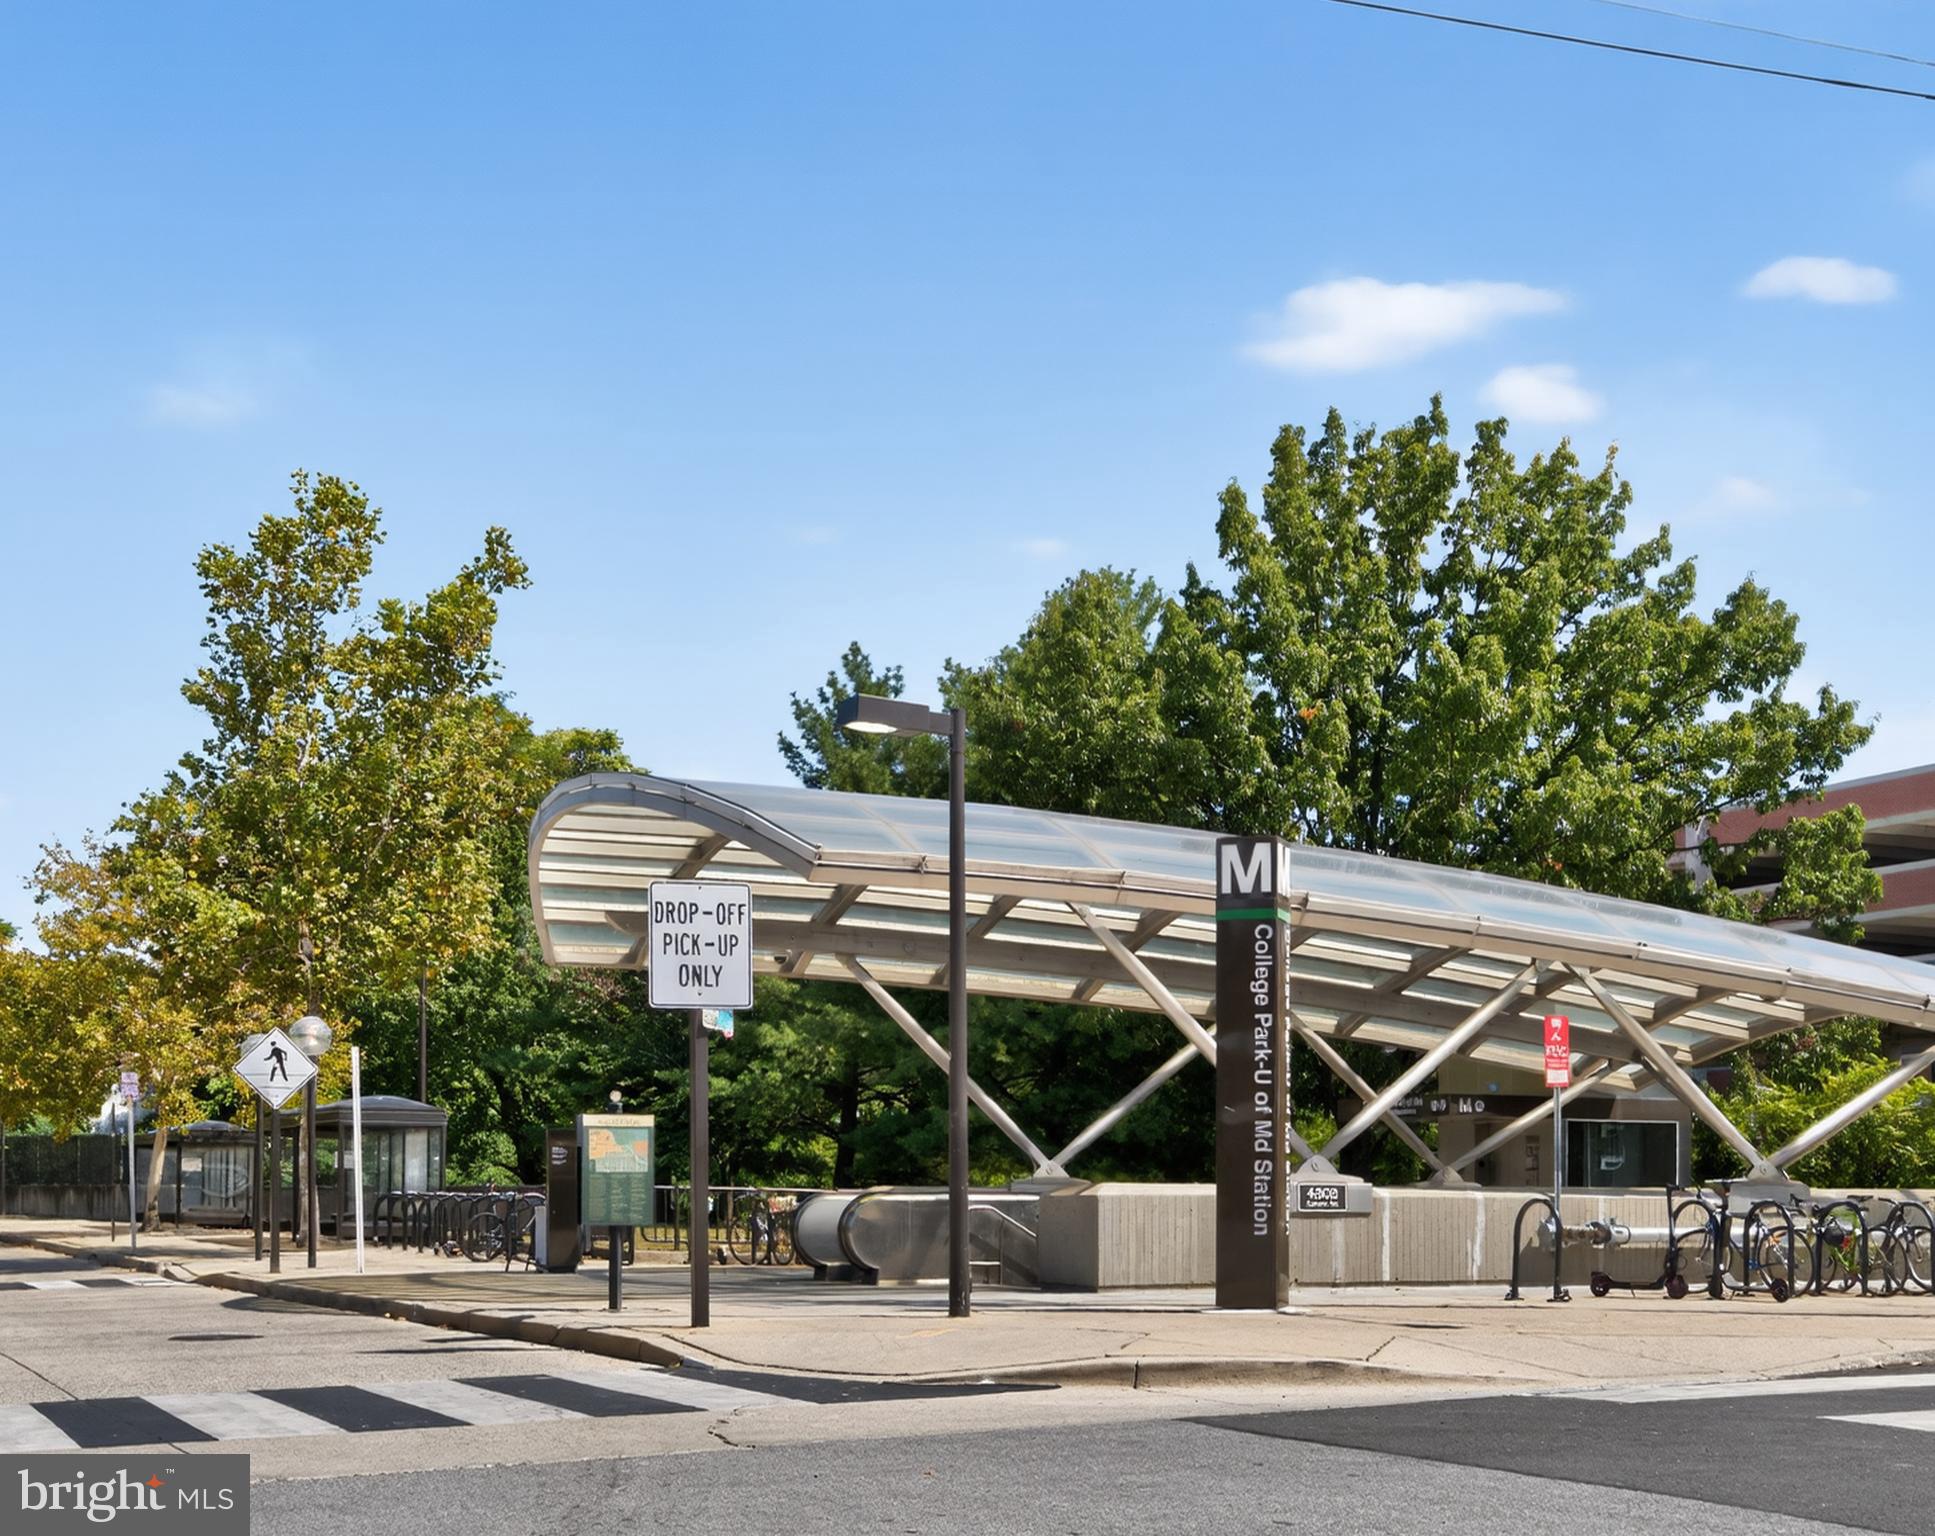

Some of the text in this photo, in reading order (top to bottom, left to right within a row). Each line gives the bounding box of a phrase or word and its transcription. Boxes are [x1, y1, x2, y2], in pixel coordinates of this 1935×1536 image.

[1220, 841, 1272, 894] M
[654, 901, 747, 925] DROP-OFF
[663, 932, 739, 957] PICK-UP
[678, 963, 723, 988] ONLY
[1249, 923, 1273, 1236] College Park-U of Md Station
